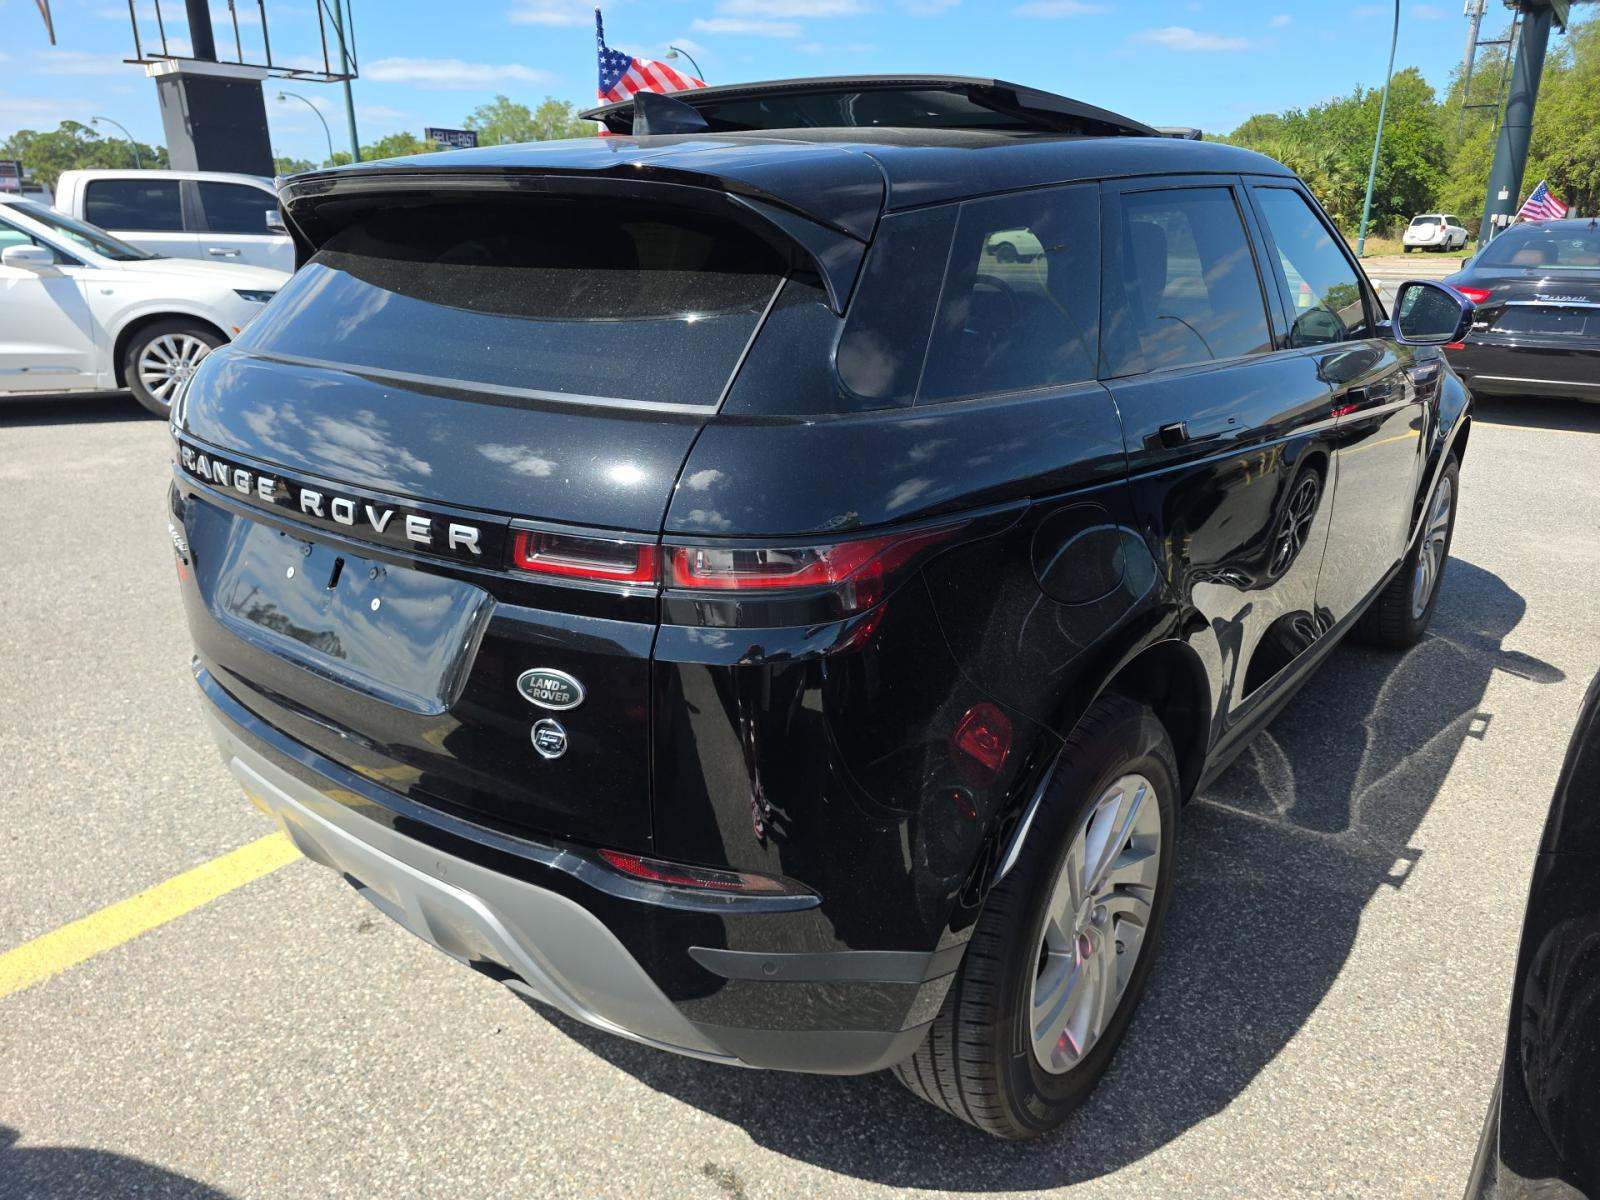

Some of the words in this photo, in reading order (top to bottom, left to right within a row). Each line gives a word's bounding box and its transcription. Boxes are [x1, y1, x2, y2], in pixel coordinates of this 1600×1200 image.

[181, 446, 277, 503] RANGE
[300, 488, 481, 555] ROVER
[530, 677, 560, 690] LAND
[533, 688, 570, 702] ROVER
